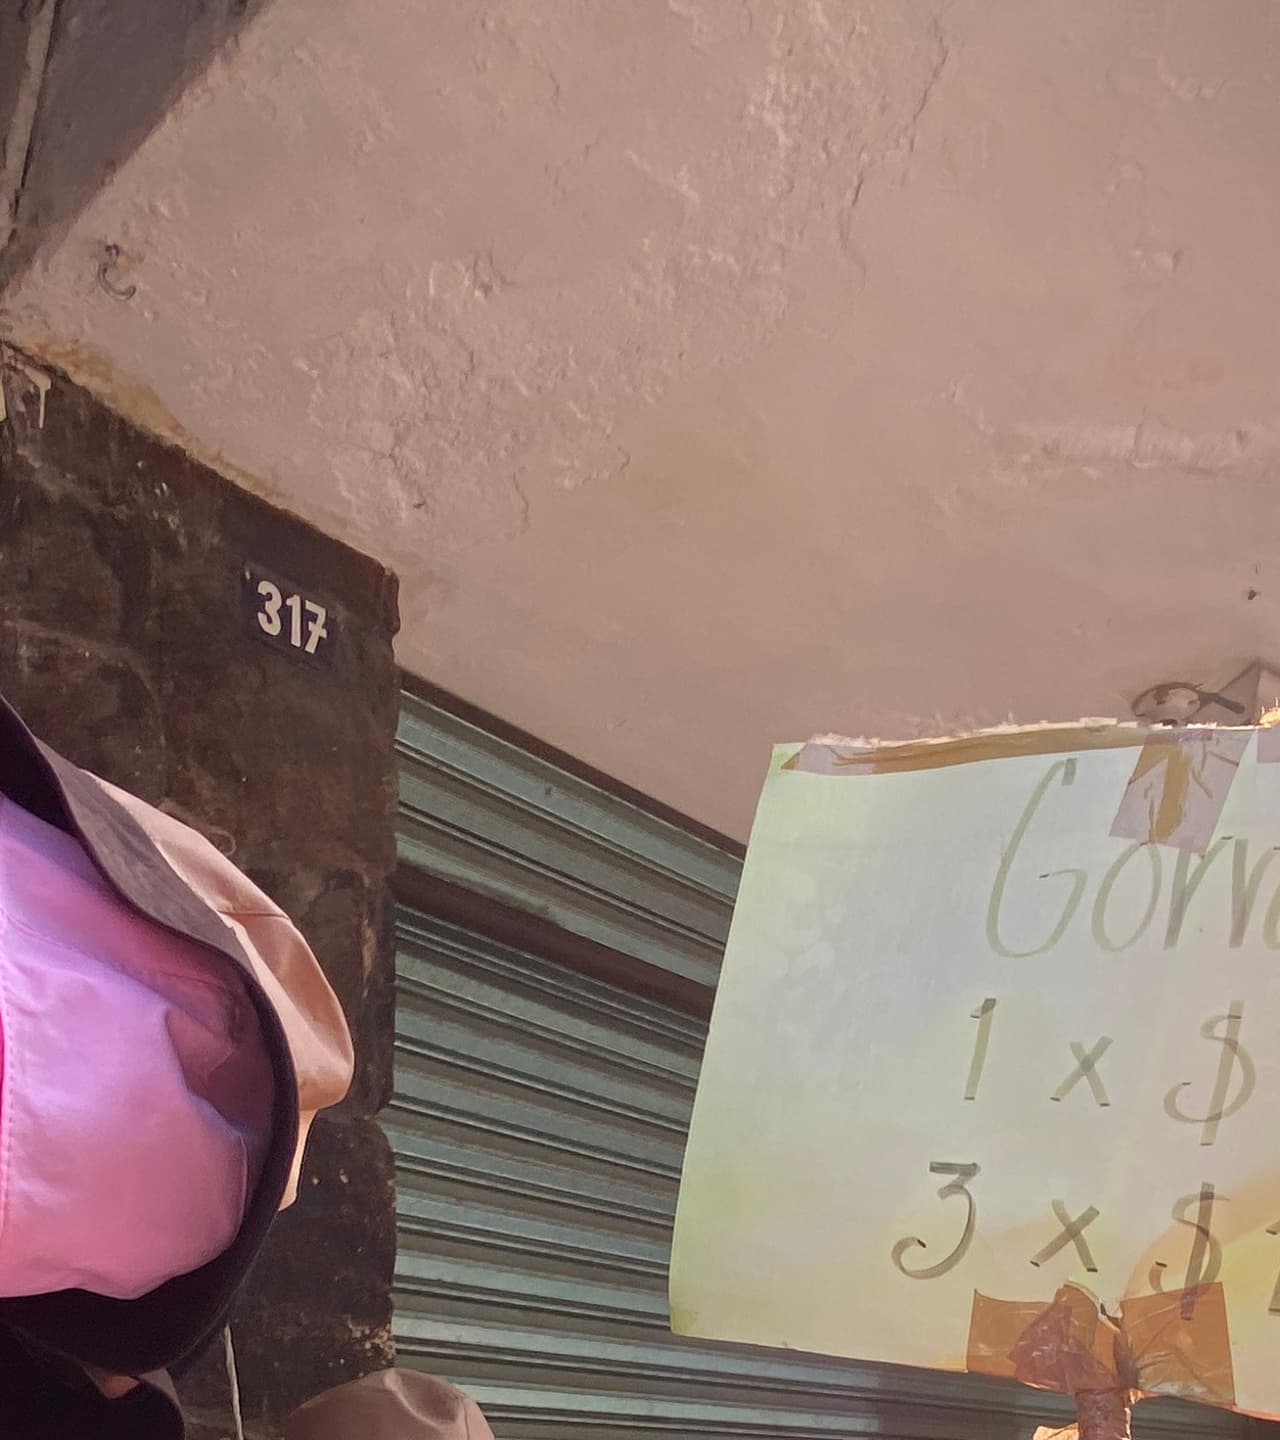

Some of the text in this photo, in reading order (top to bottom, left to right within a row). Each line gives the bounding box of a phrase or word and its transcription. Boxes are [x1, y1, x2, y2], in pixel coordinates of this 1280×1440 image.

[257, 580, 327, 654] 317
[963, 998, 997, 1101] 1
[1049, 1036, 1114, 1107] x
[890, 1161, 982, 1280] 3
[1029, 1199, 1100, 1273] x
